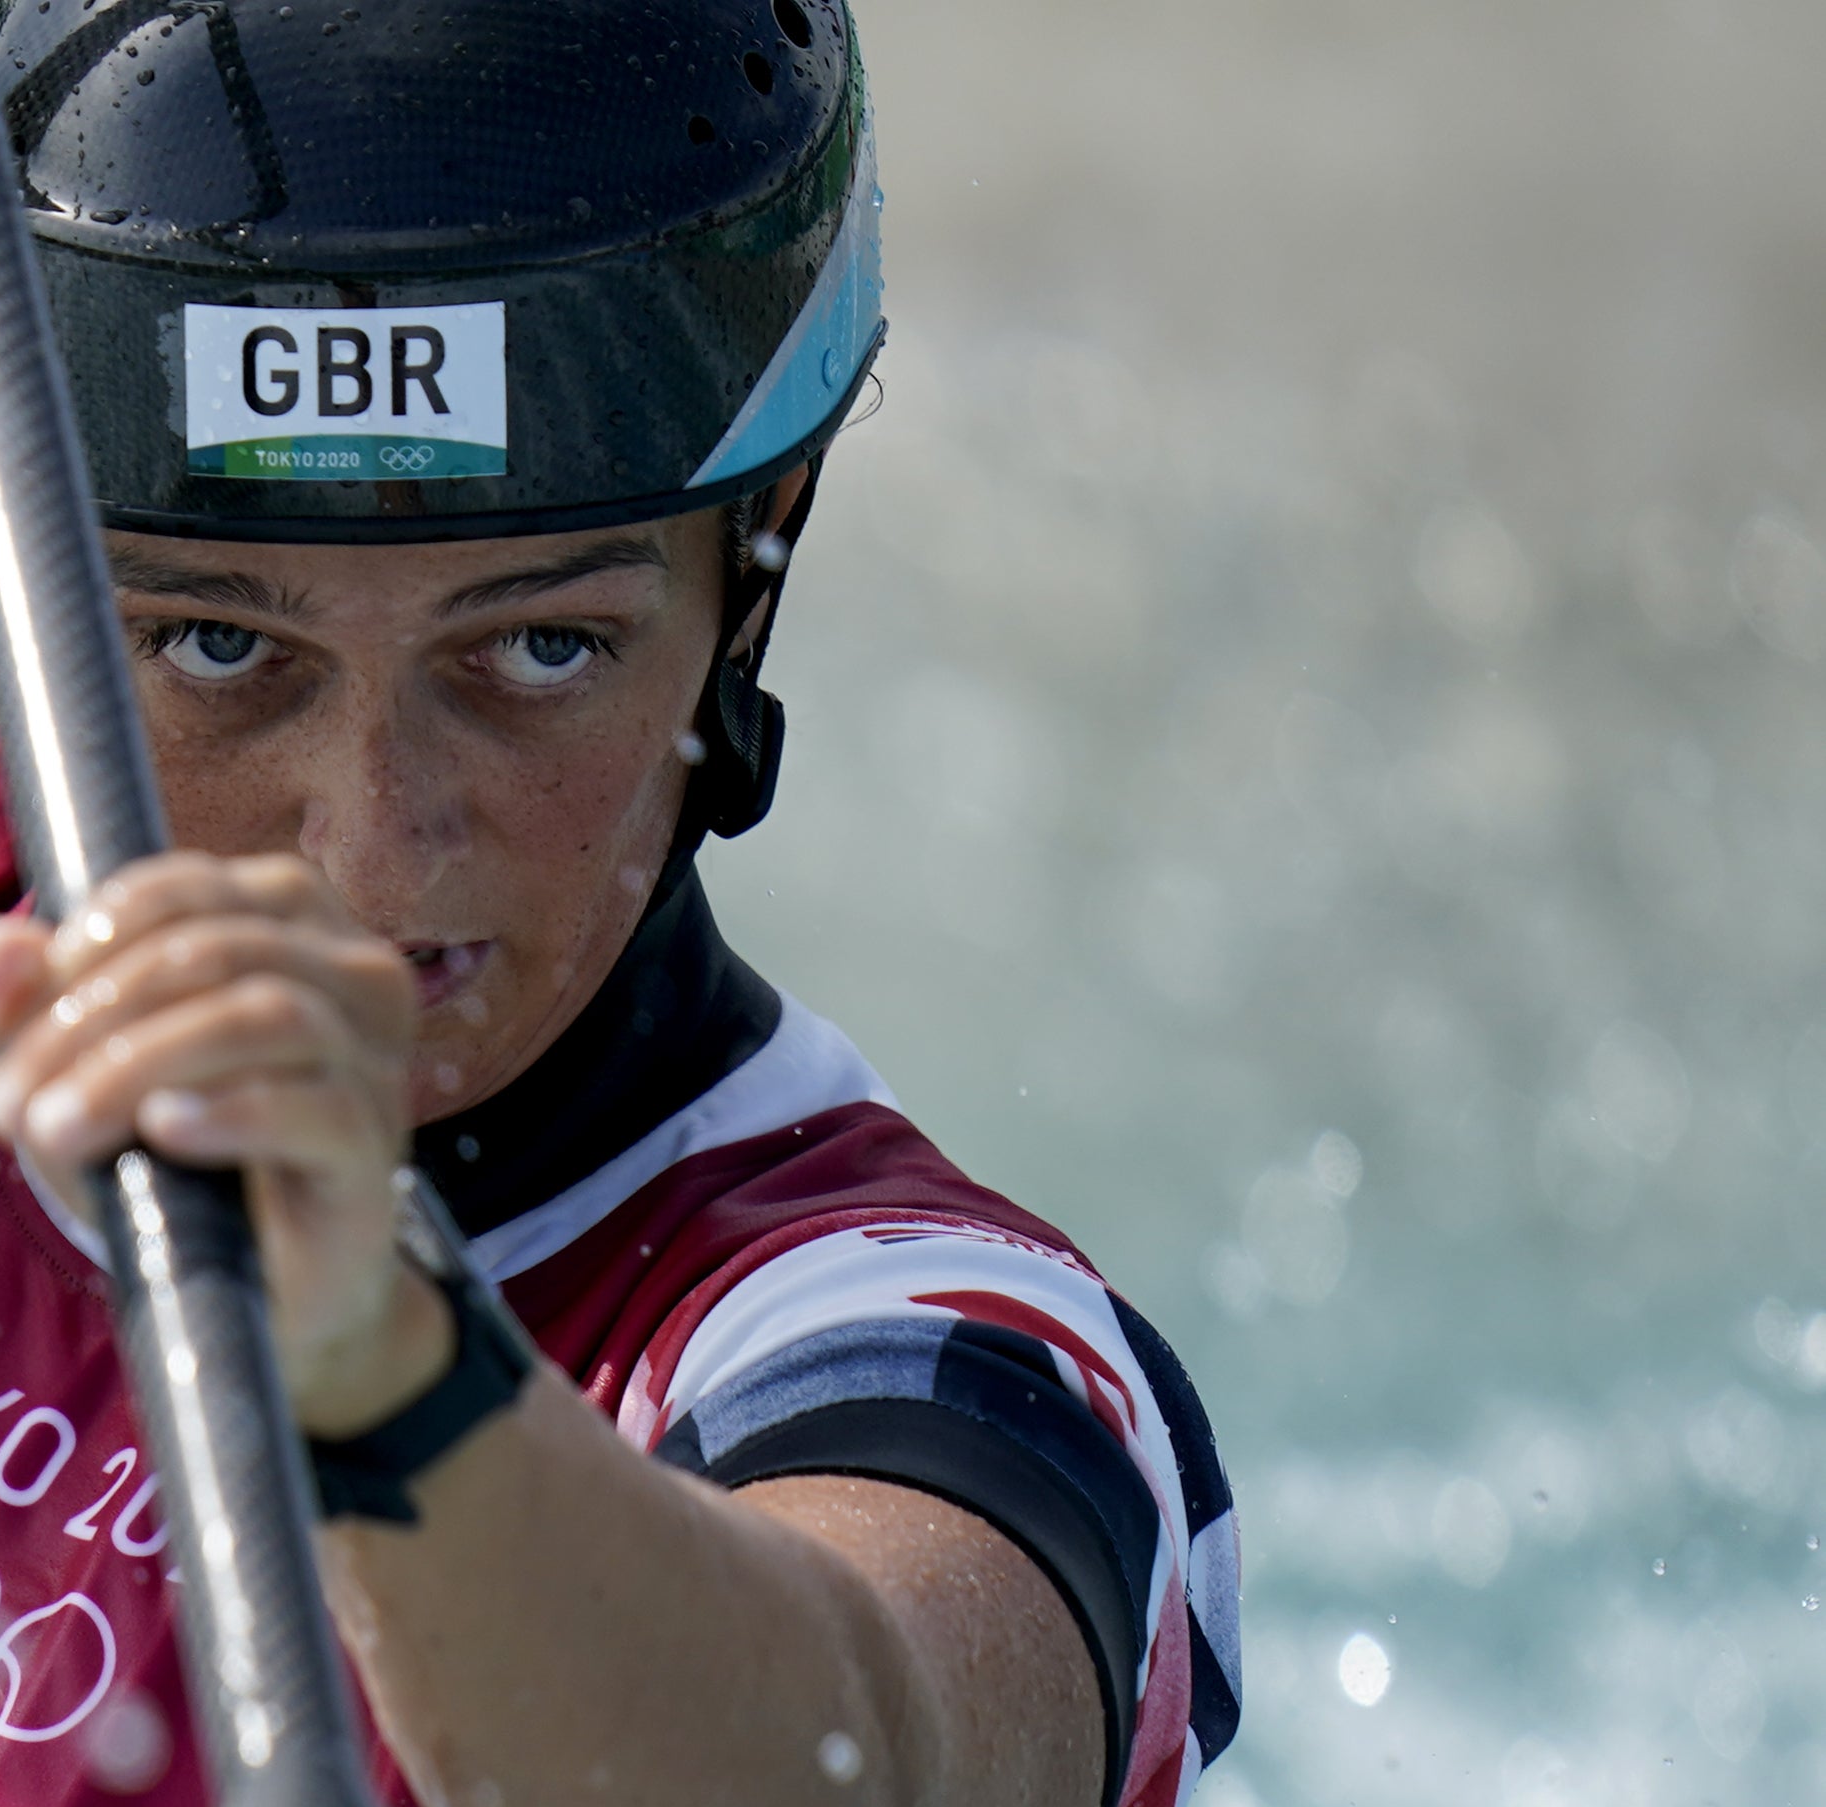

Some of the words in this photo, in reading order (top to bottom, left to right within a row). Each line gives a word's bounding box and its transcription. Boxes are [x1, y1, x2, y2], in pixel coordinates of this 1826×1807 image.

[243, 325, 451, 417] GBR
[254, 449, 314, 468] TOKYO
[316, 450, 361, 468] 2020
[63, 1446, 186, 1584] 20
